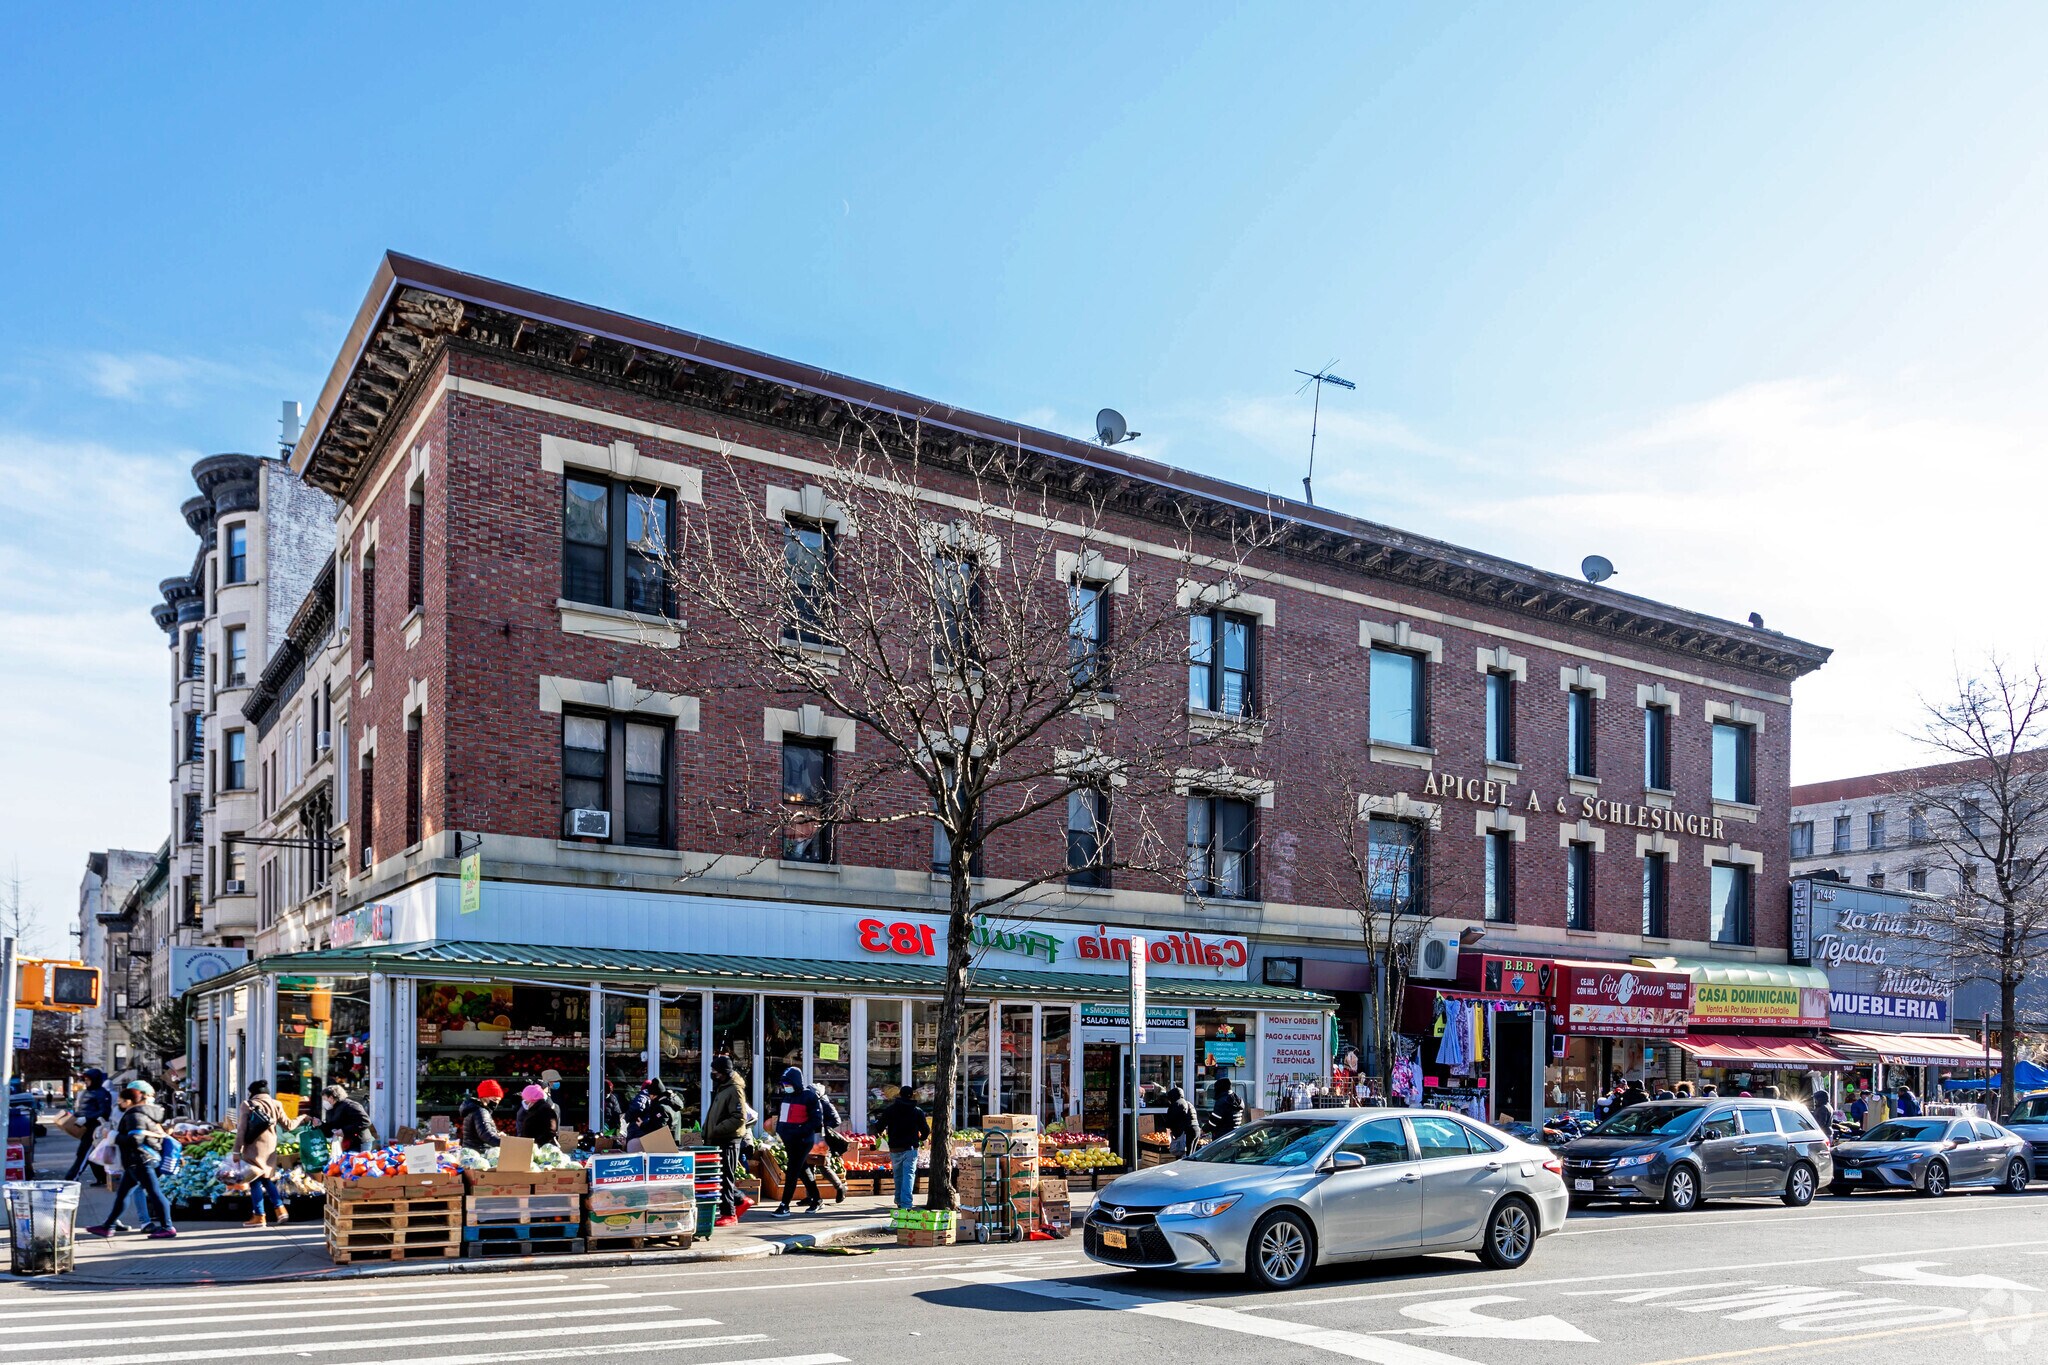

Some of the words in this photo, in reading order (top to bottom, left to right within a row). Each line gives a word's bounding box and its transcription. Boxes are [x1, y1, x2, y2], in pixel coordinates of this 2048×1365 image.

[1423, 772, 1512, 807] APICEL
[1526, 790, 1541, 812] A
[1556, 797, 1567, 814] &
[1582, 797, 1725, 840] SCHLESINGER
[1817, 889, 1837, 901] 1446
[1793, 882, 1807, 957] FURNITURE
[1838, 908, 1867, 930] La
[1816, 933, 1887, 967] Tejada
[185, 951, 213, 969] AMERICAN
[214, 953, 233, 970] LEGION
[1504, 959, 1536, 973] B.B.B.
[1580, 978, 1595, 987] CEJAS
[1599, 973, 1622, 1001] City
[1625, 975, 1665, 997] Brows
[1666, 982, 1687, 991] THREADING
[1880, 967, 1953, 998] Muebles
[1576, 987, 1587, 996] CON
[1587, 988, 1598, 996] HILO
[1670, 992, 1683, 1000] SALON
[1698, 987, 1729, 1003] CASA
[1731, 989, 1798, 1005] DOMINICANA
[1706, 1005, 1722, 1013] Venta
[1724, 1005, 1730, 1013] Al
[1741, 1006, 1758, 1015] Mayor
[1759, 1006, 1764, 1014] Y
[1770, 1007, 1790, 1015] Detalle
[1829, 993, 1939, 1019] MUEBLERIA
[1165, 1009, 1182, 1017] JUICE
[1086, 1016, 1109, 1025] SALAD
[1114, 1017, 1130, 1025] WRA
[1269, 1016, 1293, 1024] MONEY
[1293, 1017, 1319, 1025] ORDERS
[1265, 1032, 1283, 1040] PAGO
[1292, 1033, 1322, 1041] CUENTAS
[1272, 1056, 1315, 1064] TELEFÓNICAS
[1901, 1055, 1927, 1065] TEJADA
[1927, 1056, 1959, 1066] MUEBLES
[609, 1159, 630, 1167] APPLES
[603, 1175, 636, 1183] Fortress
